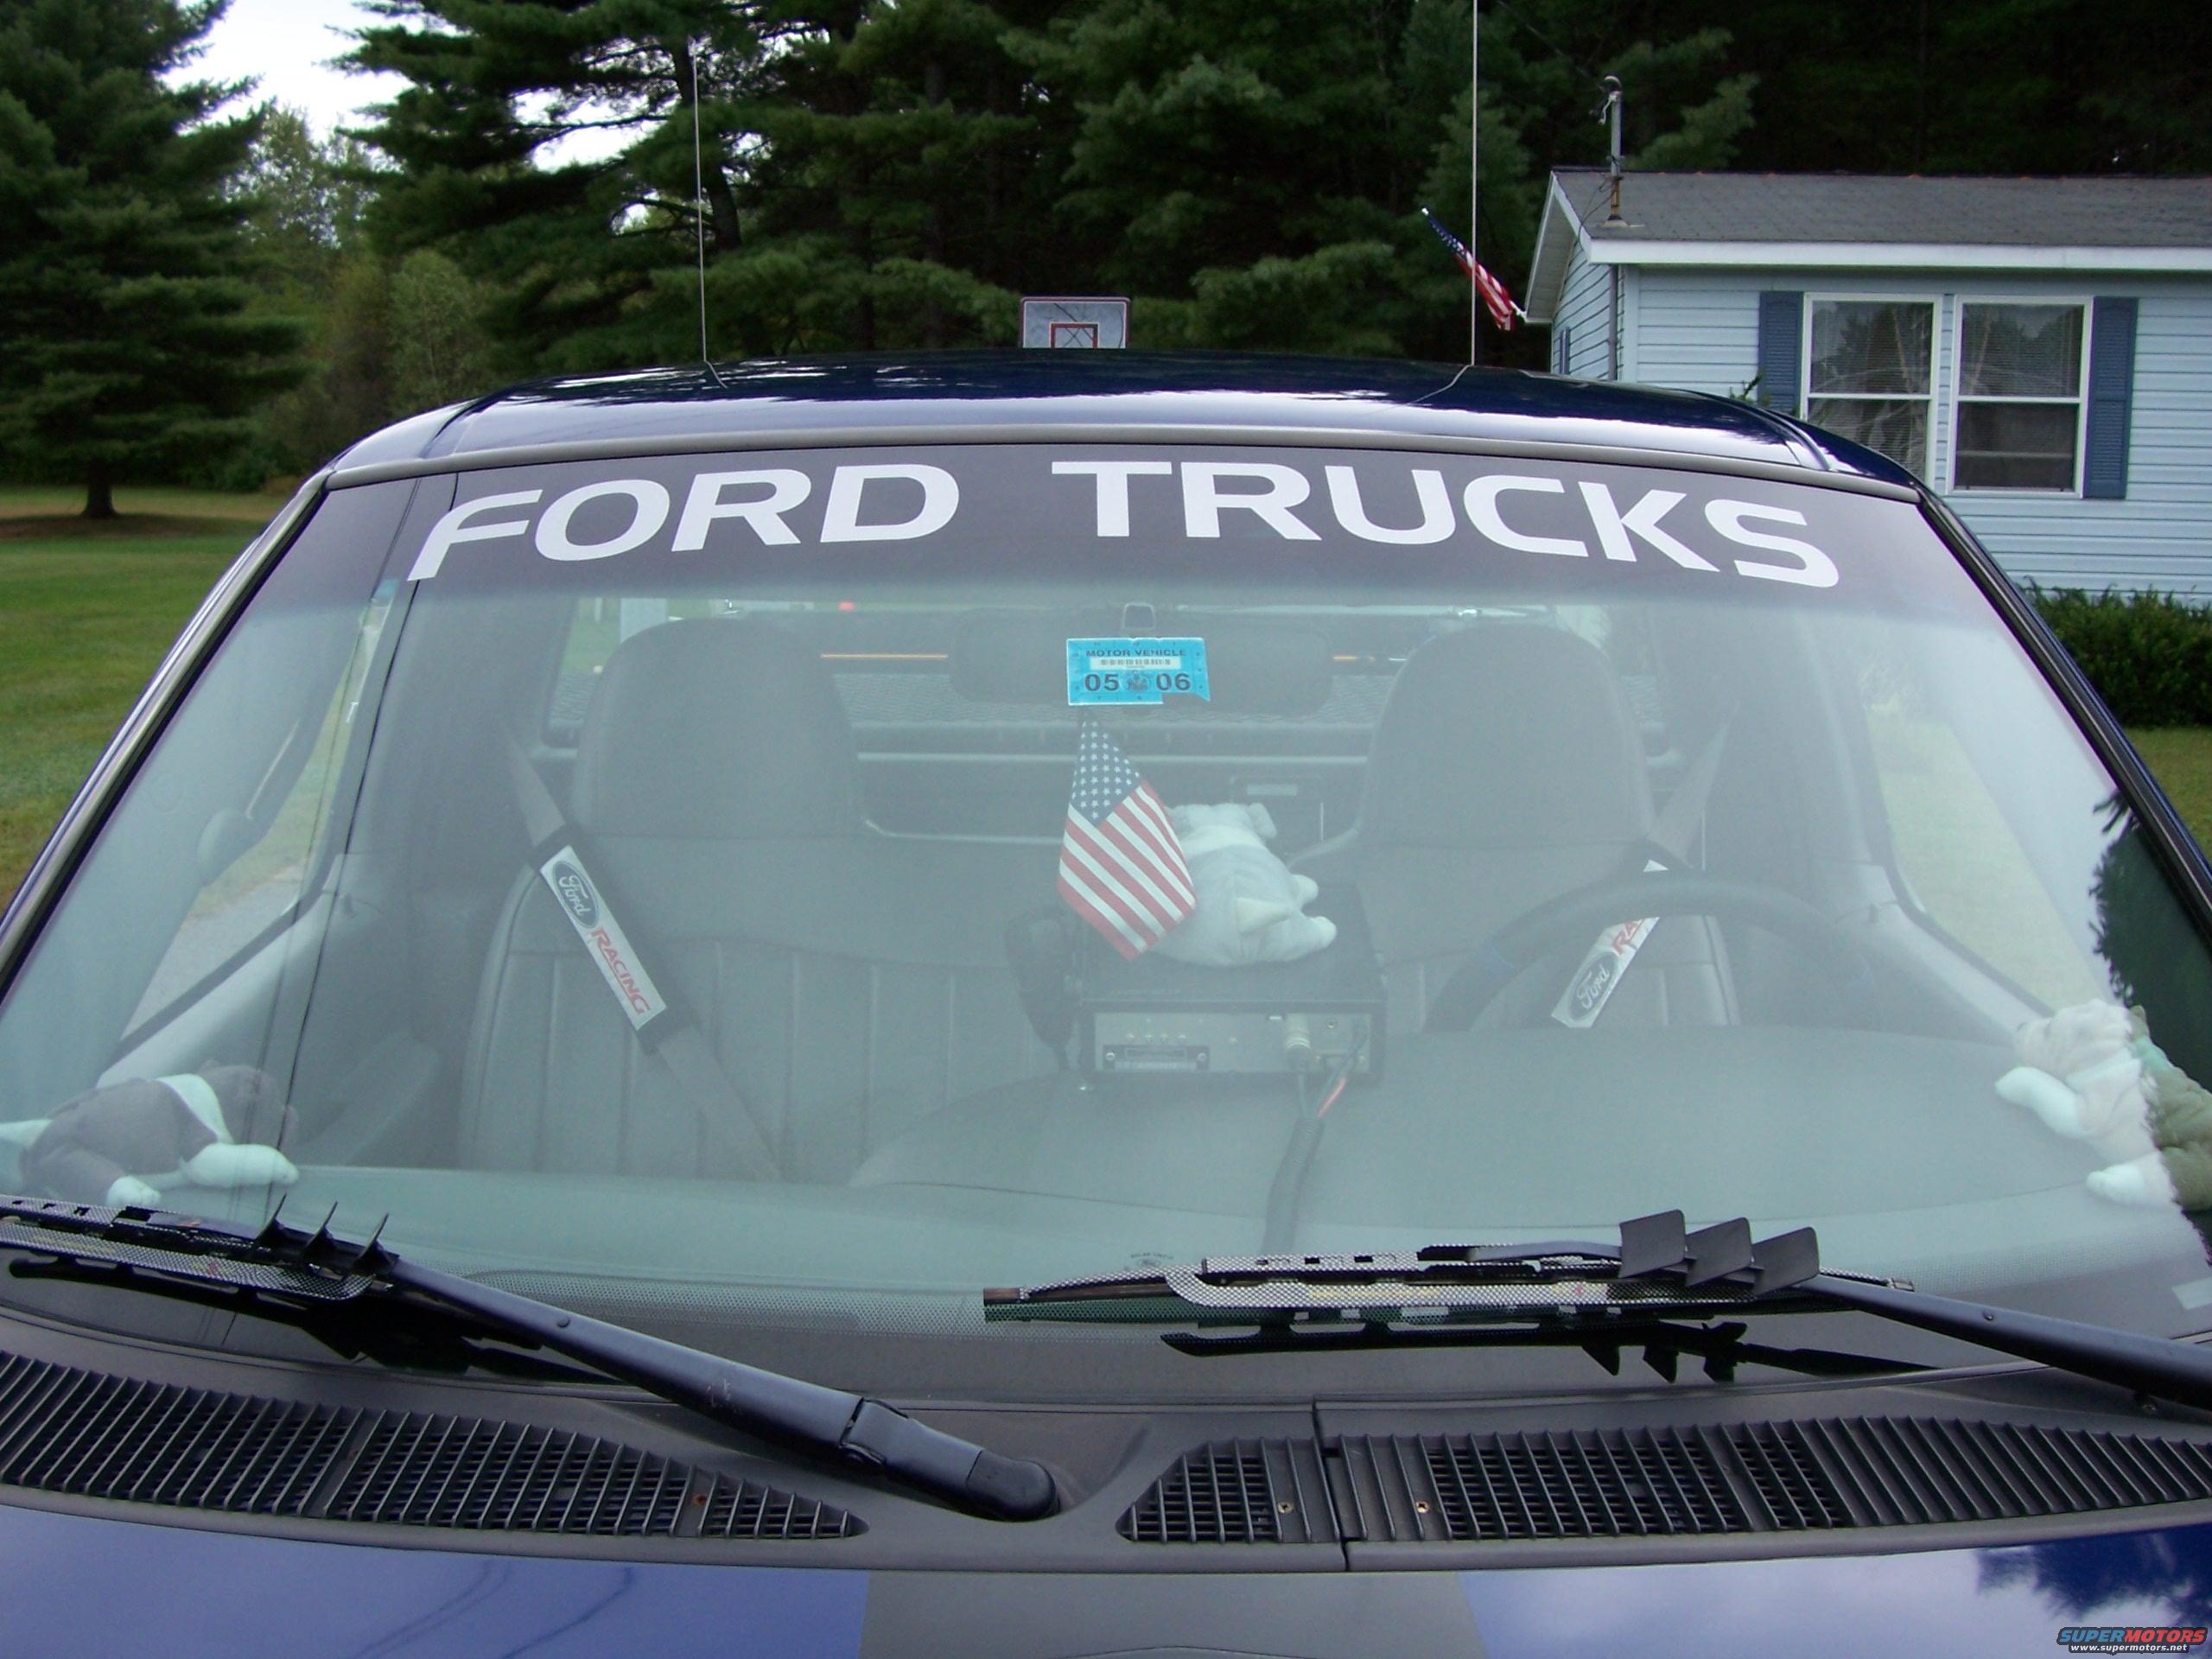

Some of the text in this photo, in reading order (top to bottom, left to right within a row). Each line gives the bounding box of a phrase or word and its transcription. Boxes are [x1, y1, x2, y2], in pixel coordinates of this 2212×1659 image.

[407, 461, 1839, 588] FORD TRUCKS
[1135, 648, 1186, 657] VEHICLE
[1084, 672, 1191, 691] 05 06
[559, 874, 650, 1015] Ford RACING
[1576, 963, 1610, 1009] Ford
